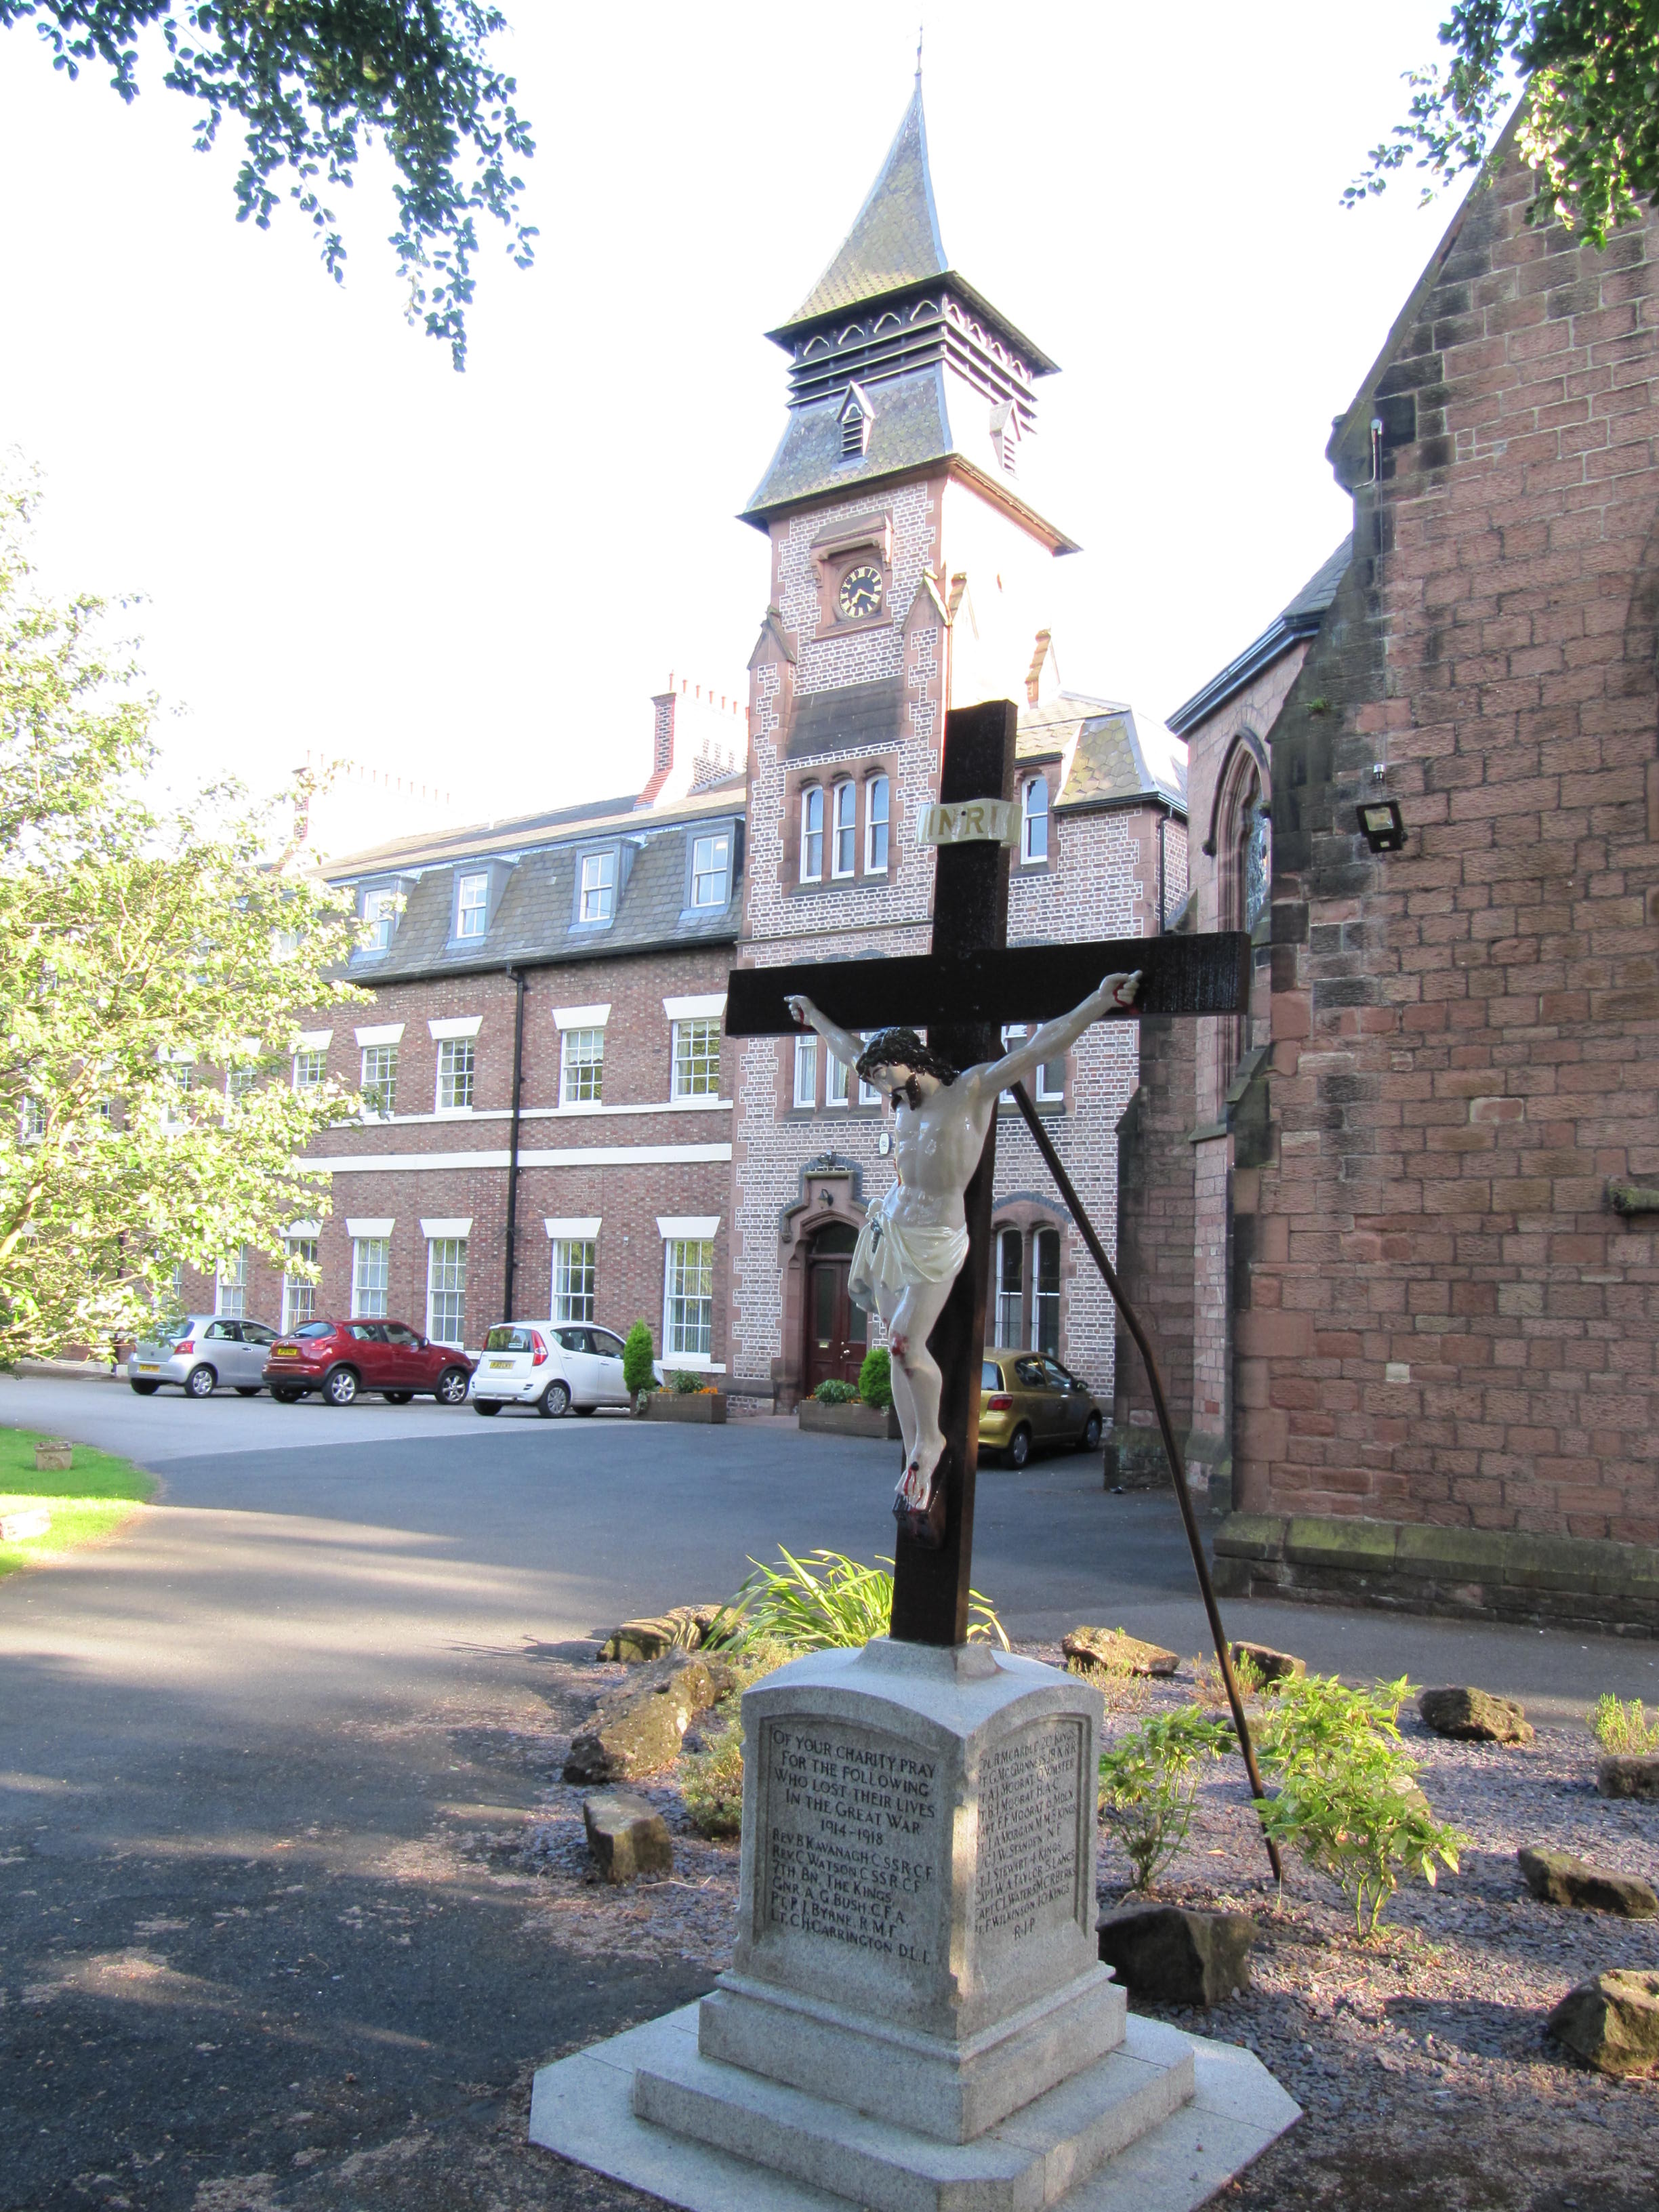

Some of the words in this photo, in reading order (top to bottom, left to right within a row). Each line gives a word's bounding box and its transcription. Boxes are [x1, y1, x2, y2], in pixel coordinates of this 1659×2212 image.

[773, 1730, 792, 1746] OF
[796, 1736, 832, 1757] YOUR
[836, 1745, 896, 1771] CHARITY
[900, 1758, 936, 1779] PRAY
[782, 1750, 806, 1770] FOR
[812, 1759, 838, 1778] THE
[843, 1765, 928, 1797] FOLLOWING
[775, 1767, 808, 1788] WHO
[813, 1779, 846, 1798] LOST
[853, 1788, 892, 1809] THEIR
[897, 1797, 935, 1818] LIVES
[786, 1788, 800, 1805] IN
[806, 1795, 832, 1814] THE
[836, 1801, 882, 1826] GREAT
[886, 1812, 920, 1835] WAR
[796, 1833, 804, 1847] B
[806, 1835, 868, 1865] KAVANAGH
[807, 1851, 857, 1878] WATSON
[773, 1859, 796, 1878] 7TH
[827, 1874, 850, 1893] THE
[773, 1875, 800, 1896] GNR
[811, 1920, 893, 1953] CARRINGTON
